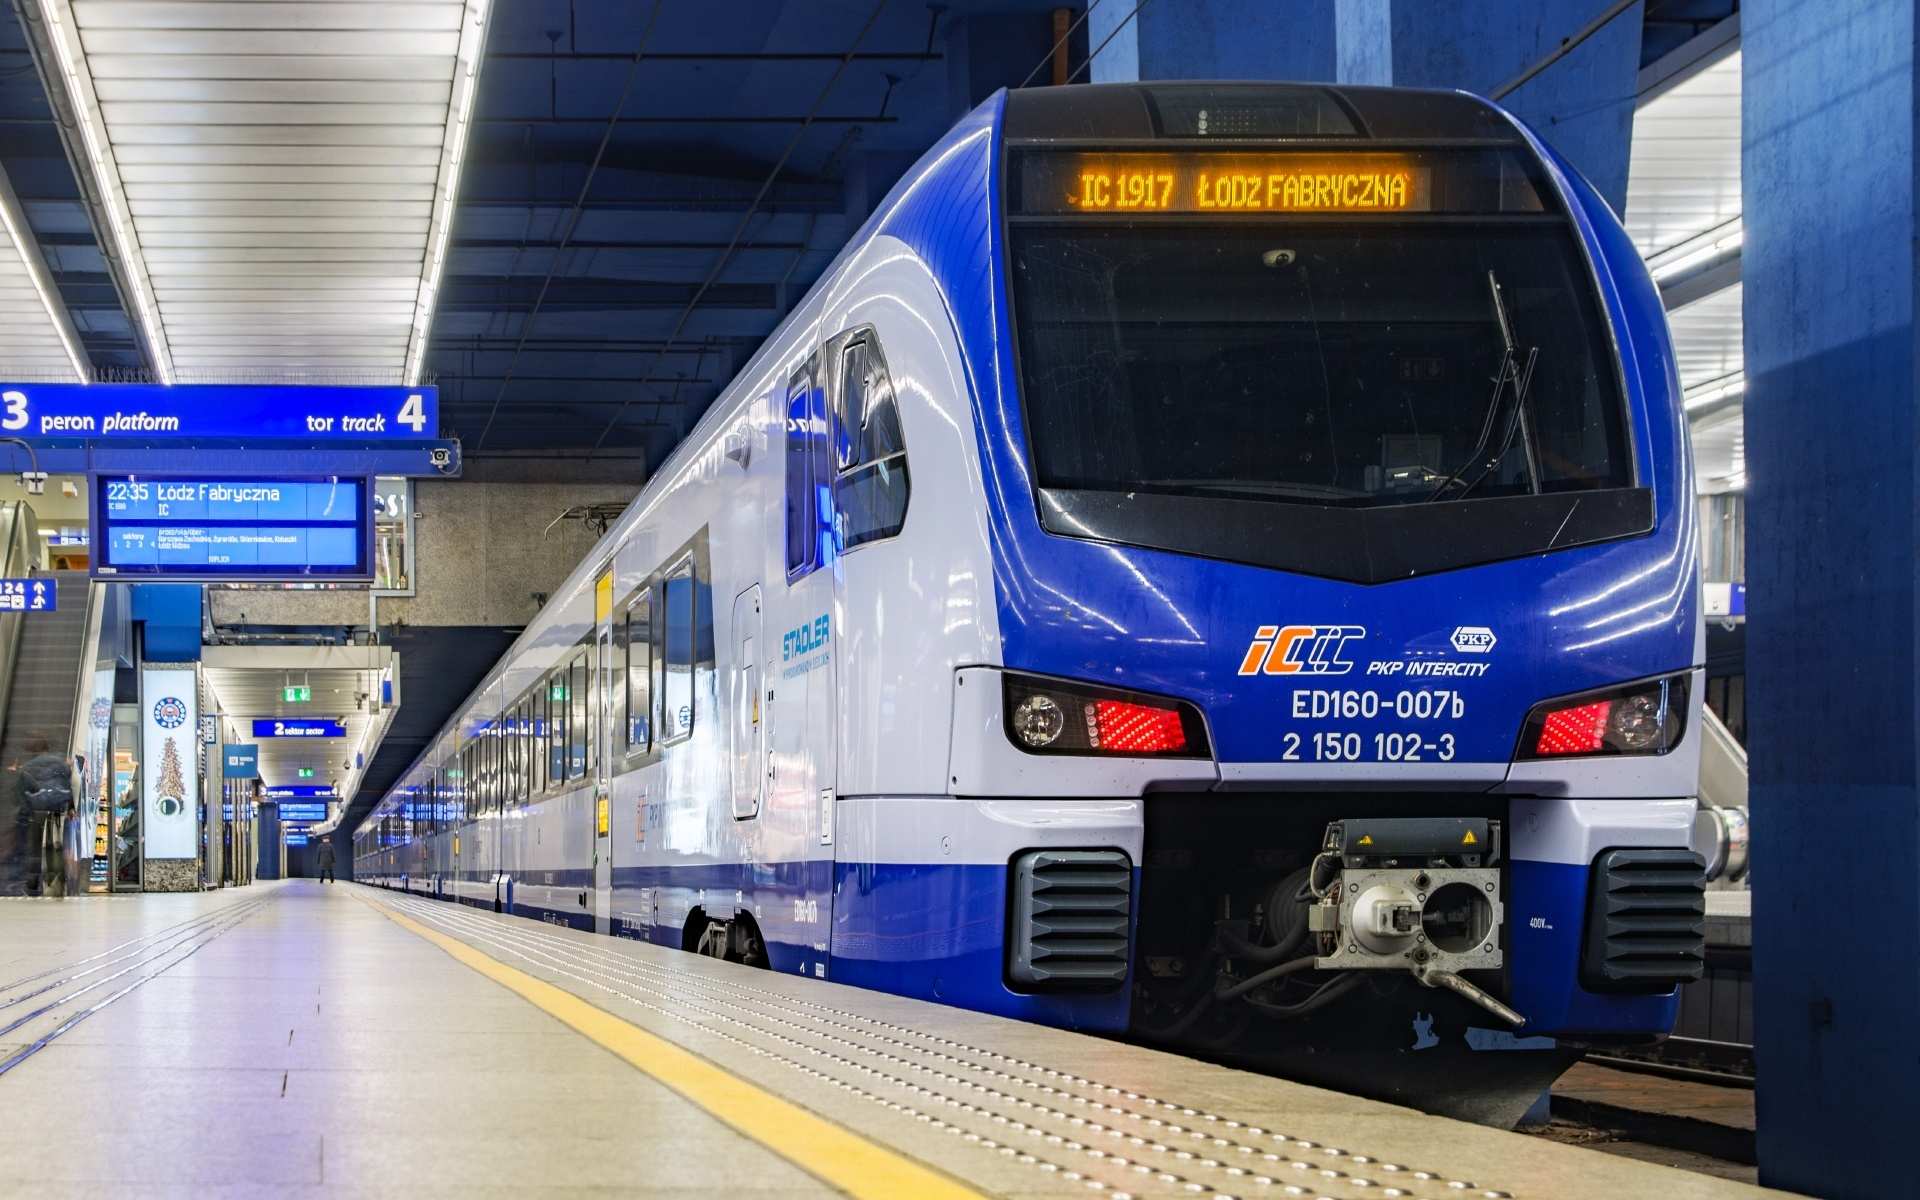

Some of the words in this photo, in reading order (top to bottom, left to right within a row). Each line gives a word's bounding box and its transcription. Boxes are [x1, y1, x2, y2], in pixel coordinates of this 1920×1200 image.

[1082, 174, 1110, 206] IC
[1116, 174, 1173, 207] 1917
[1267, 174, 1407, 207] FABRYCZNA
[2, 390, 29, 430] 3
[41, 415, 95, 434] peron
[102, 412, 179, 434] platform
[306, 415, 334, 431] tor
[342, 413, 386, 432] track
[397, 394, 427, 432] 4
[108, 484, 149, 500] 22:35
[199, 484, 280, 502] Fabryczna
[158, 503, 169, 516] IC
[783, 613, 829, 662] STADLER
[1457, 634, 1491, 646] PKP
[1366, 661, 1404, 676] PKP
[1405, 662, 1491, 677] INTERCITY
[1292, 690, 1465, 719] ED160-007b
[274, 722, 284, 736] 2
[1282, 732, 1301, 761] 2
[1312, 732, 1362, 761] 150
[1374, 732, 1456, 761] 102-3
